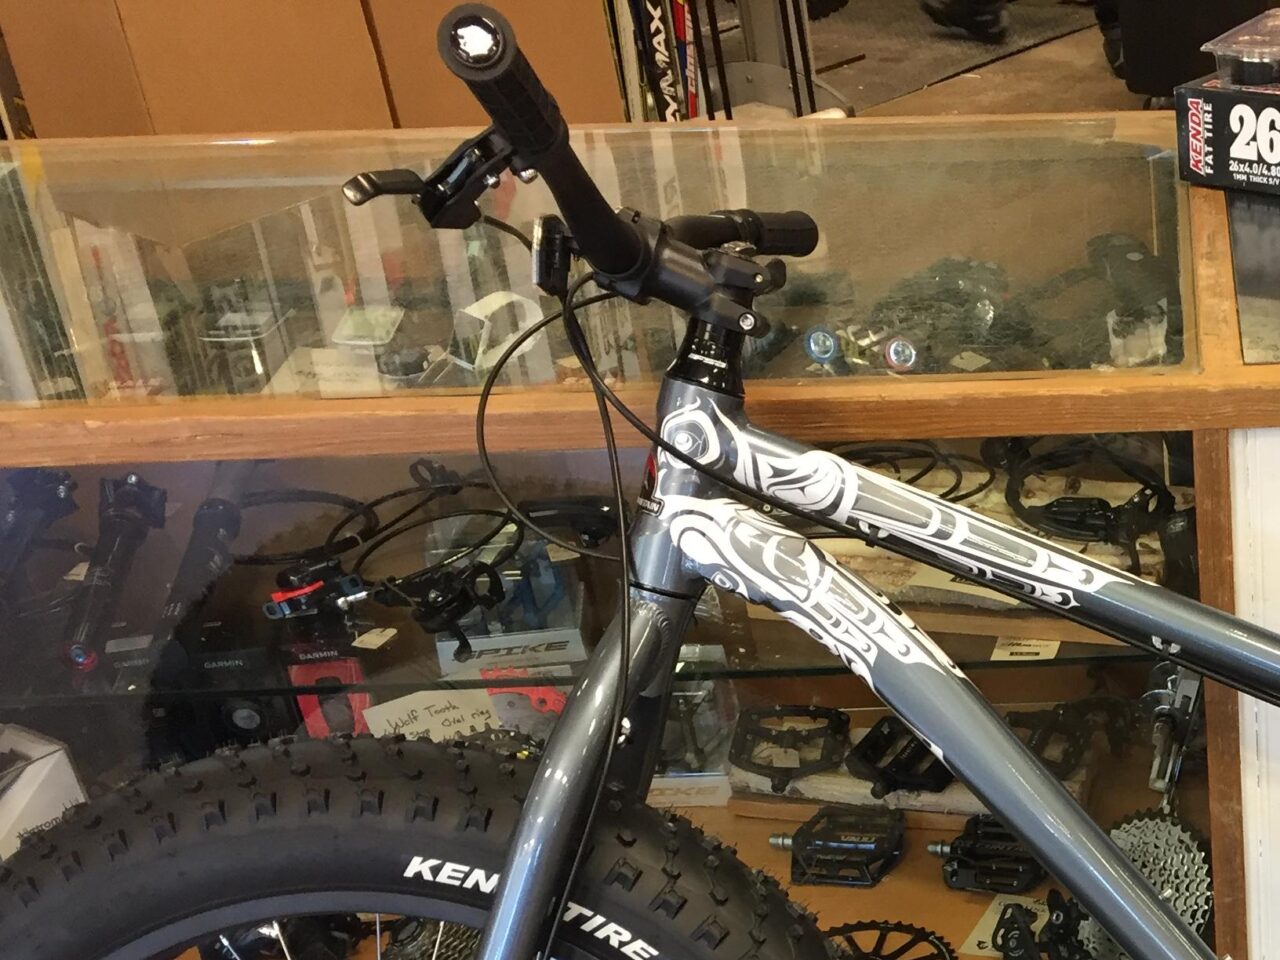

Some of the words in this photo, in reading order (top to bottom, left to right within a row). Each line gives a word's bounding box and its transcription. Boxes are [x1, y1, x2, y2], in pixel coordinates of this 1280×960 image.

[1203, 102, 1214, 139] TIRE
[1188, 98, 1206, 177] KENDA
[1204, 154, 1214, 175] FAT
[1233, 173, 1248, 181] 1MM
[1249, 174, 1268, 184] THICK
[1268, 177, 1280, 186] S/V
[299, 650, 339, 661] GARMIN
[204, 659, 244, 670] GARMIN
